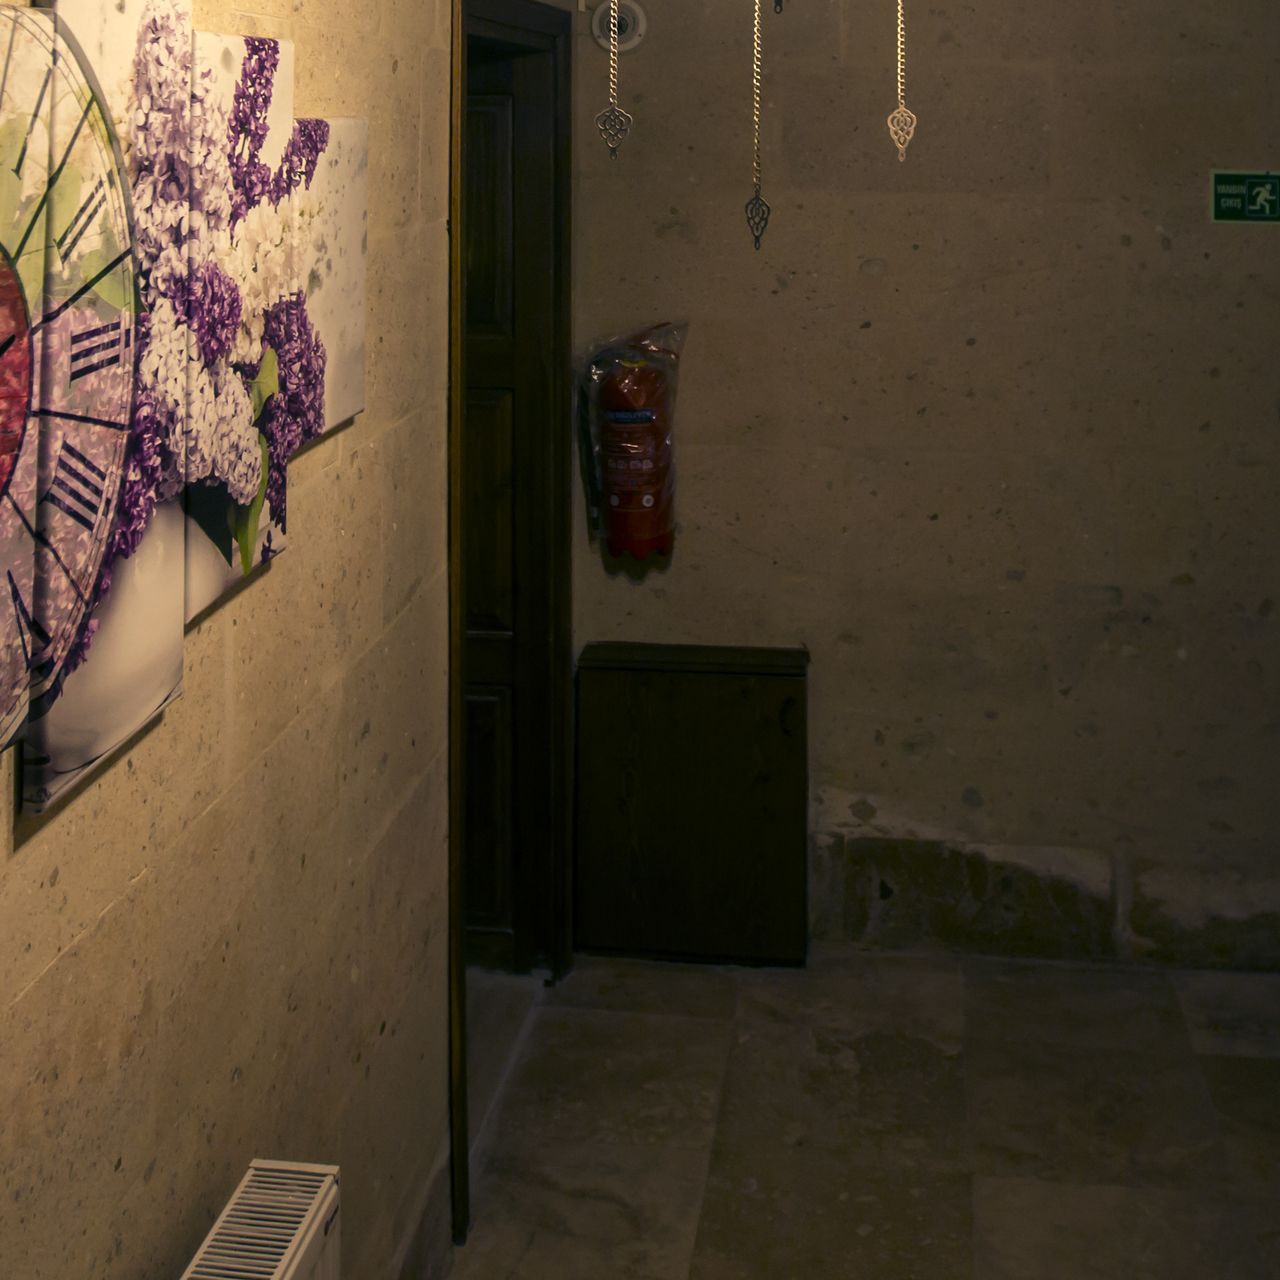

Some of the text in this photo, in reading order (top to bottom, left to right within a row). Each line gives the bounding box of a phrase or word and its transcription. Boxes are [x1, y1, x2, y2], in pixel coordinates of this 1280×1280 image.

[53, 173, 107, 265] II
[69, 320, 122, 389] III
[38, 433, 107, 531] IIII
